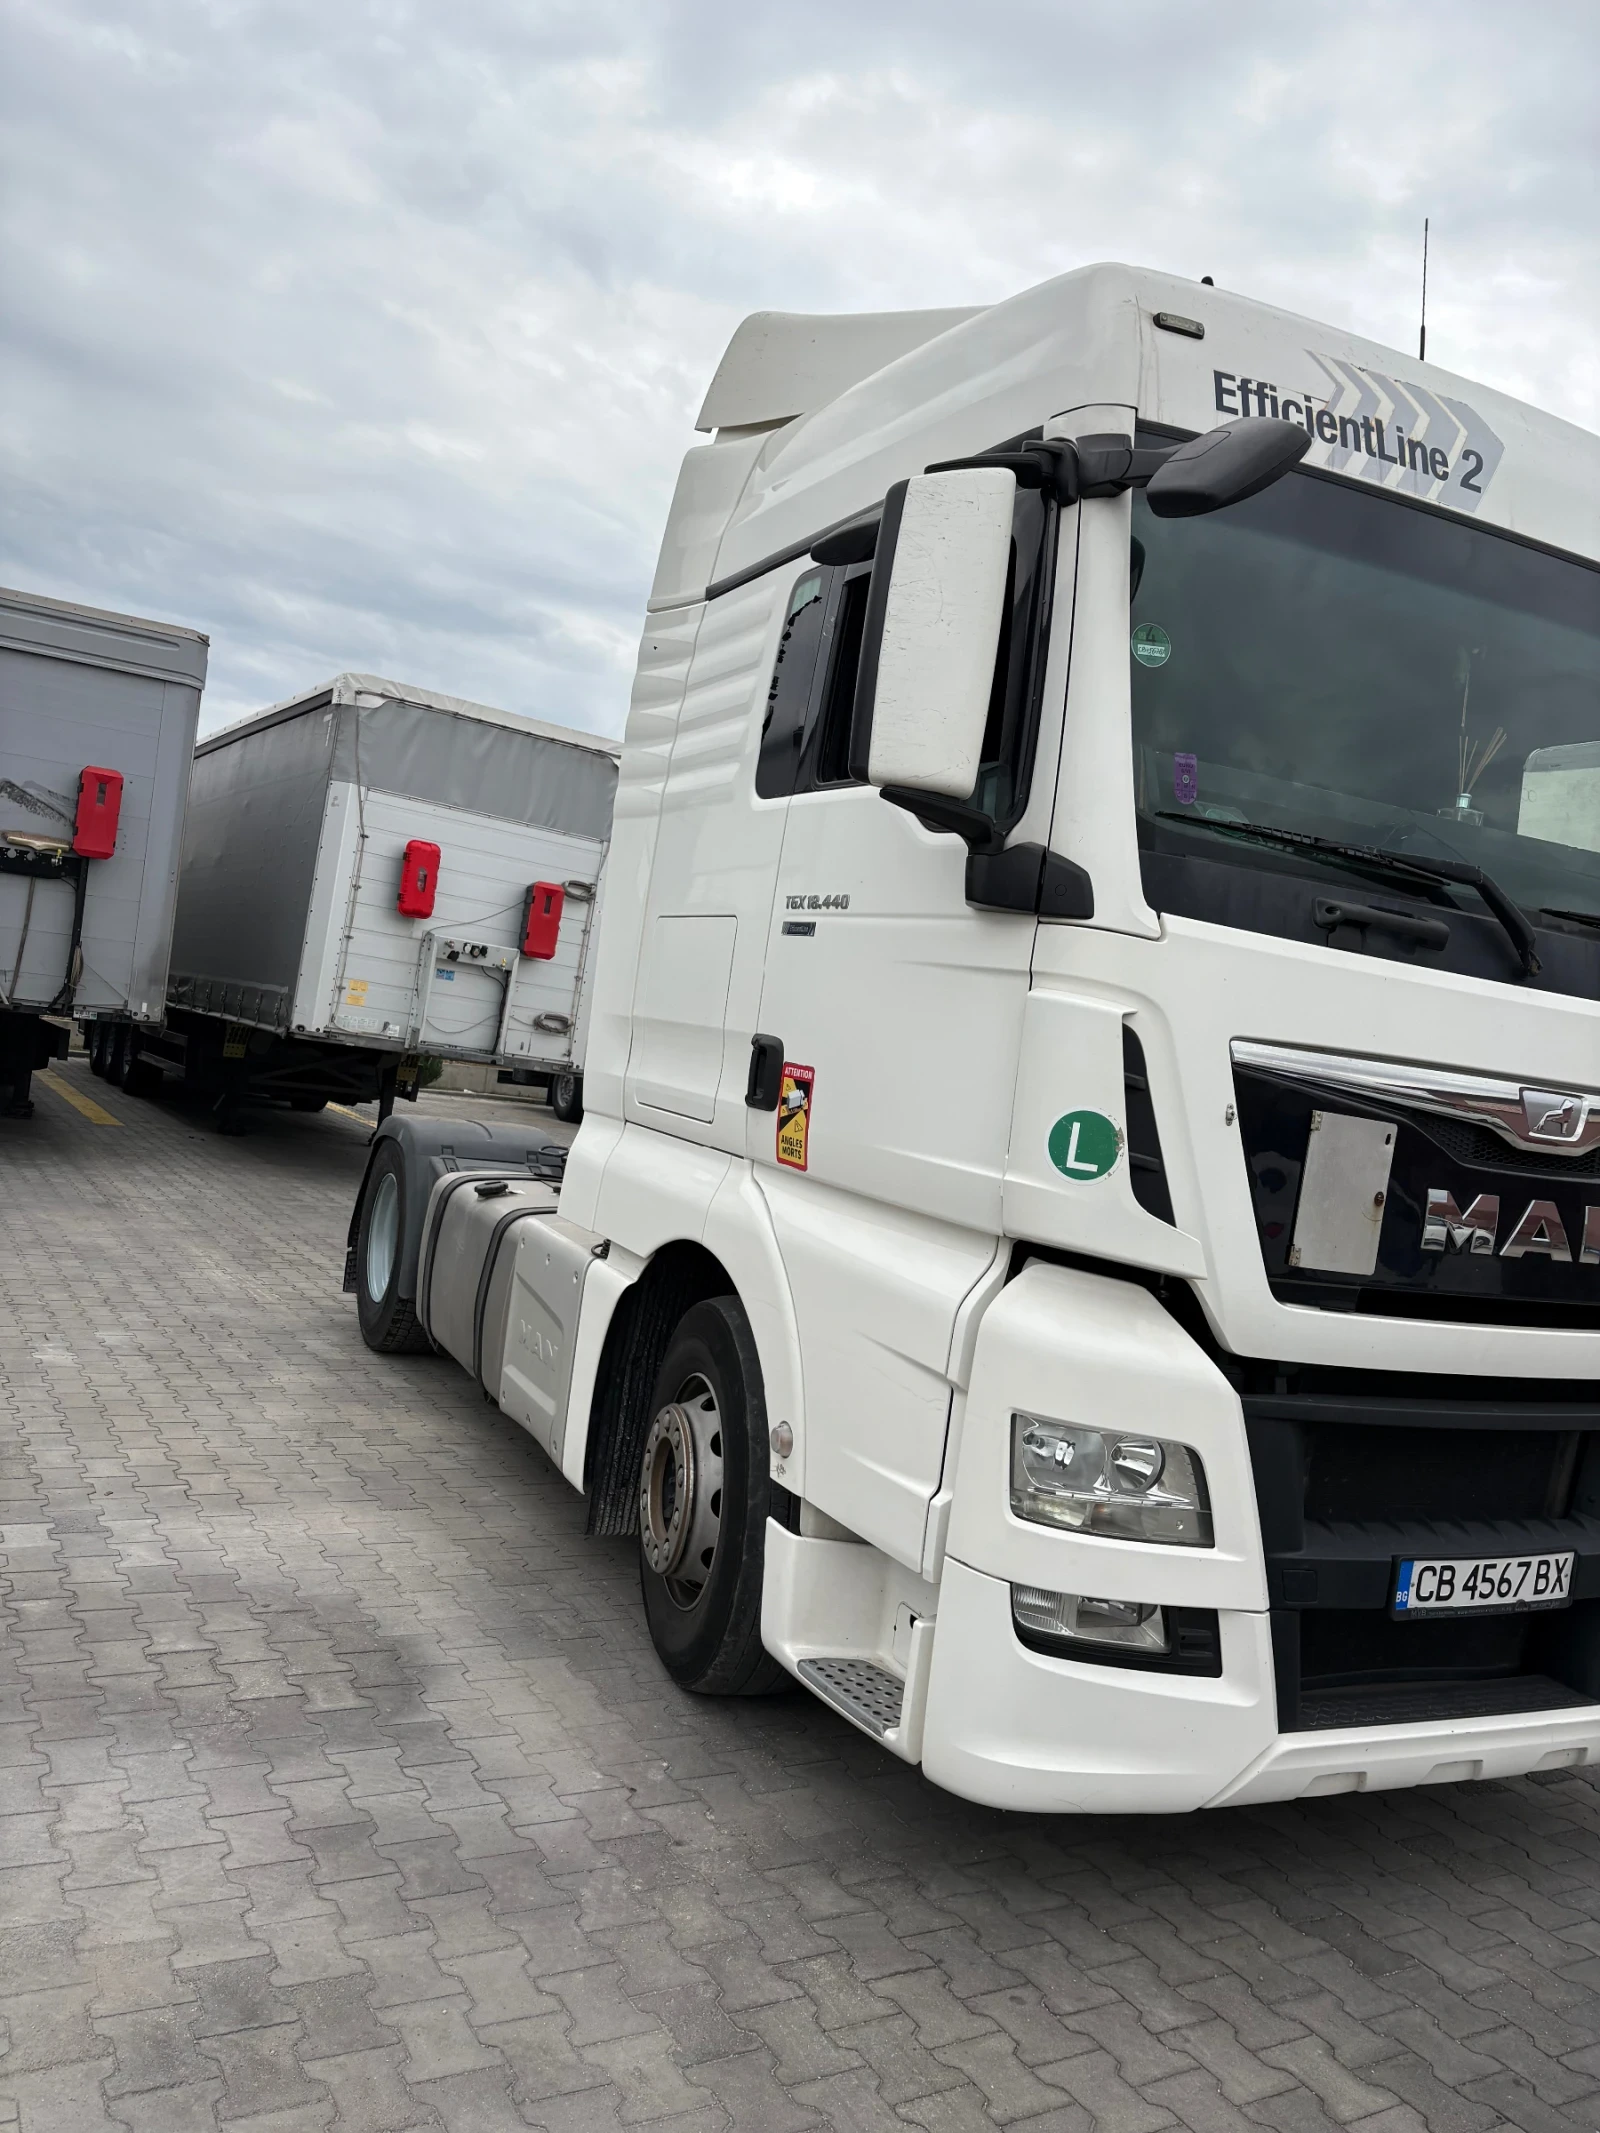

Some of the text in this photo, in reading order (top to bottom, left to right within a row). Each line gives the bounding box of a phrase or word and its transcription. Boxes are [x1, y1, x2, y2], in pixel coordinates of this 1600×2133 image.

[1213, 370, 1484, 494] EfficientLine 2
[785, 894, 850, 910] TGX 18.440
[784, 1066, 813, 1080] ATTENTION
[780, 1134, 803, 1149] ANGLES
[1066, 1121, 1099, 1172] L
[781, 1146, 802, 1160] MORTS
[1415, 1557, 1569, 1602] CB 4567 BX
[1396, 1590, 1408, 1602] BG
